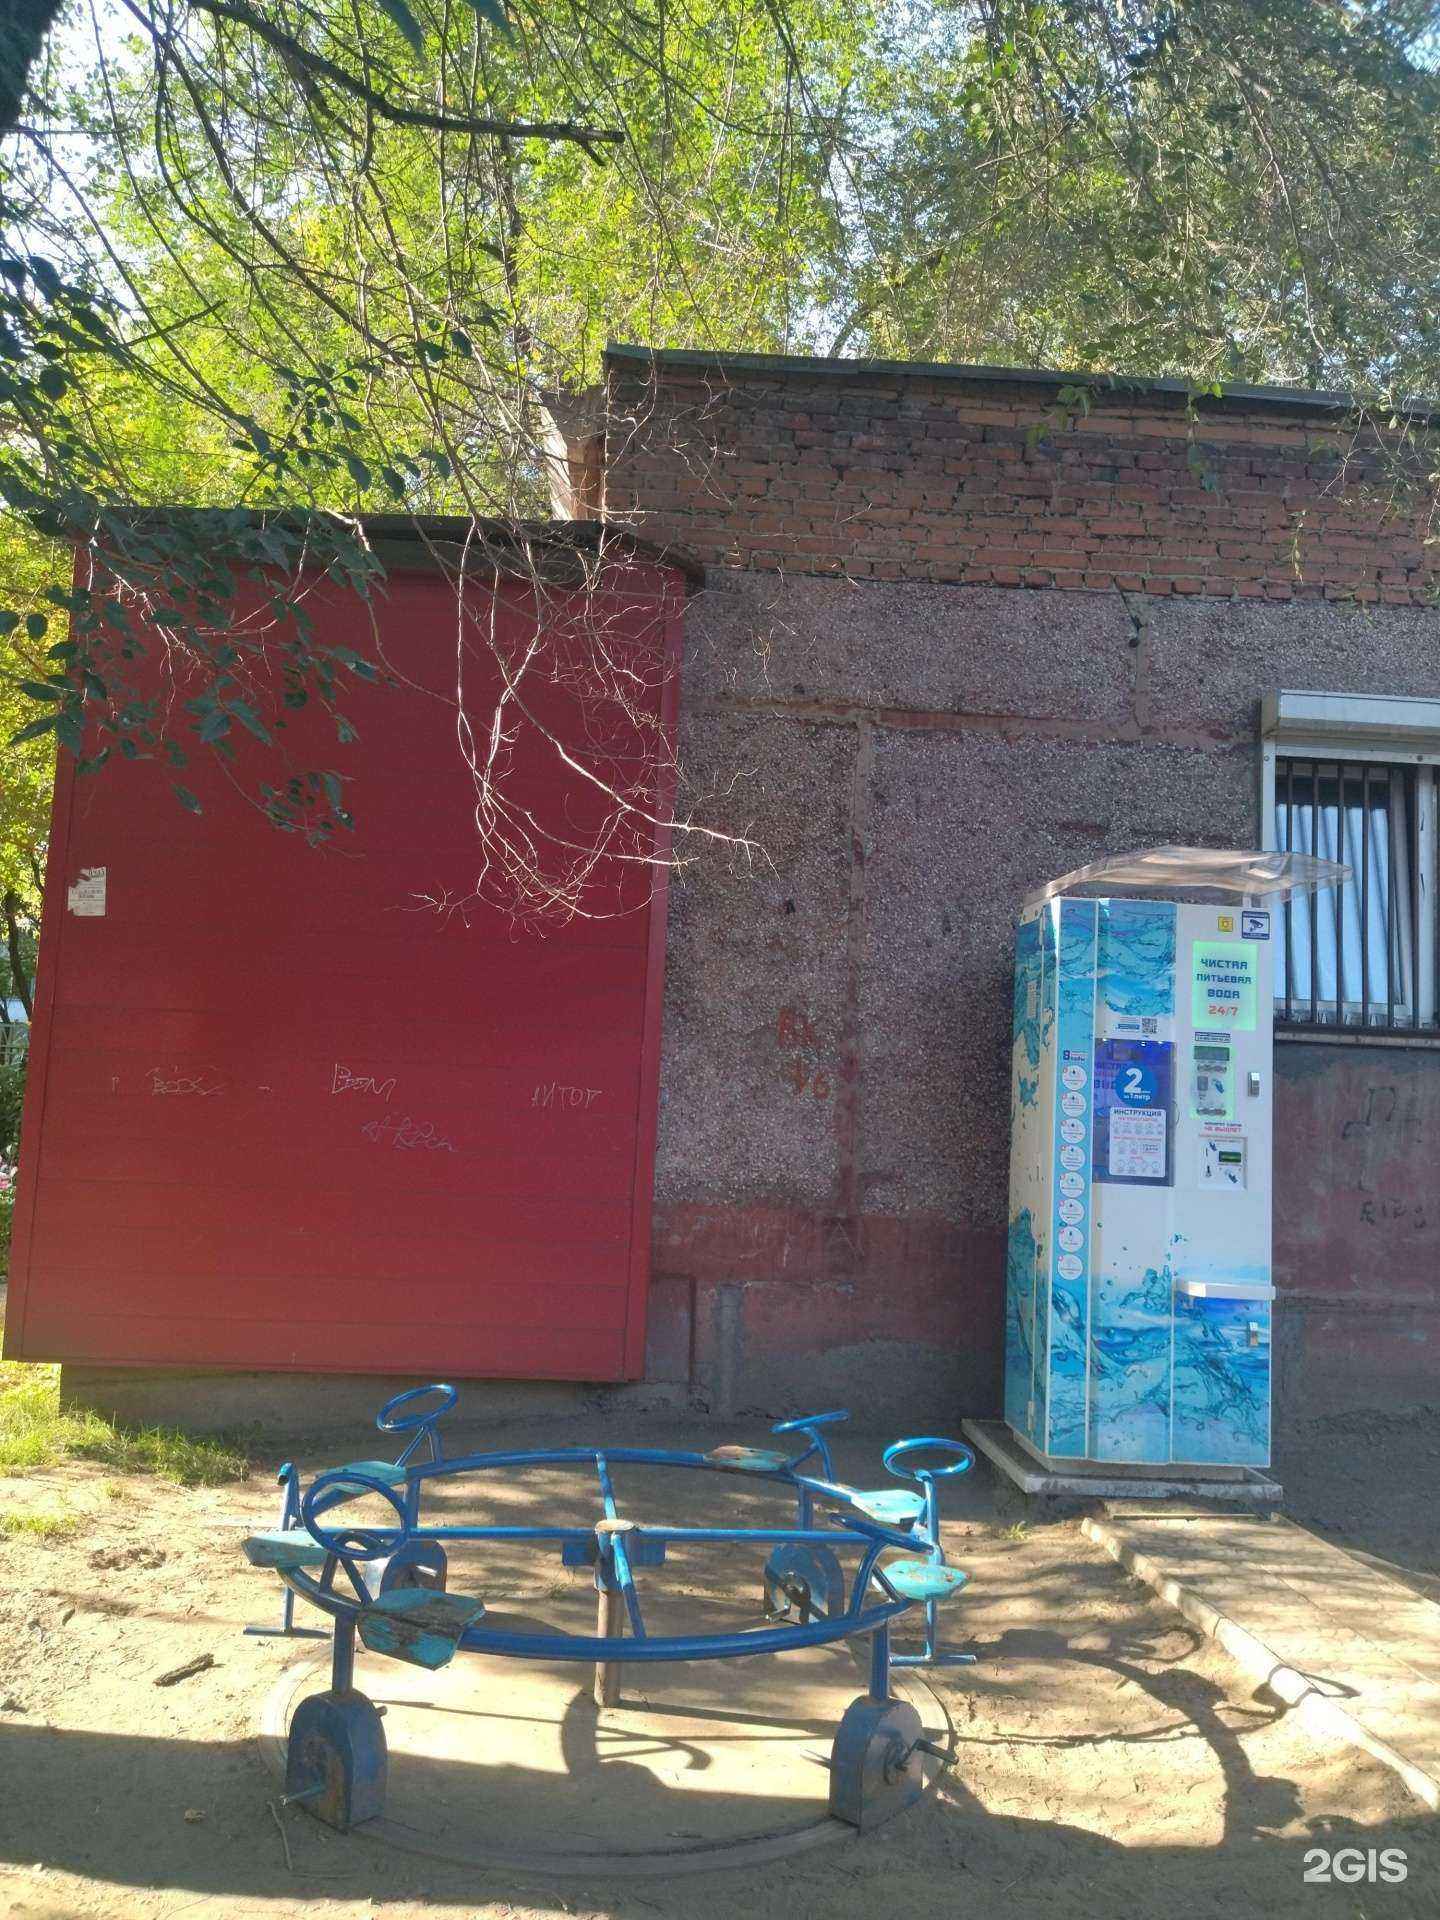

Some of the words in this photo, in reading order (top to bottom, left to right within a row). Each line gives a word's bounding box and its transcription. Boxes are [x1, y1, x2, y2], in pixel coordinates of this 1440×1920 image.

[1200, 959, 1248, 970] ЧИСТАЯ
[1196, 973, 1251, 984] ПИТЬЕВАЯ
[1207, 988, 1240, 999] ВОДА
[1208, 1005, 1238, 1016] 24/7
[1124, 1068, 1142, 1093] 2
[1113, 1109, 1162, 1117] ИНСТРУКЦИЯ
